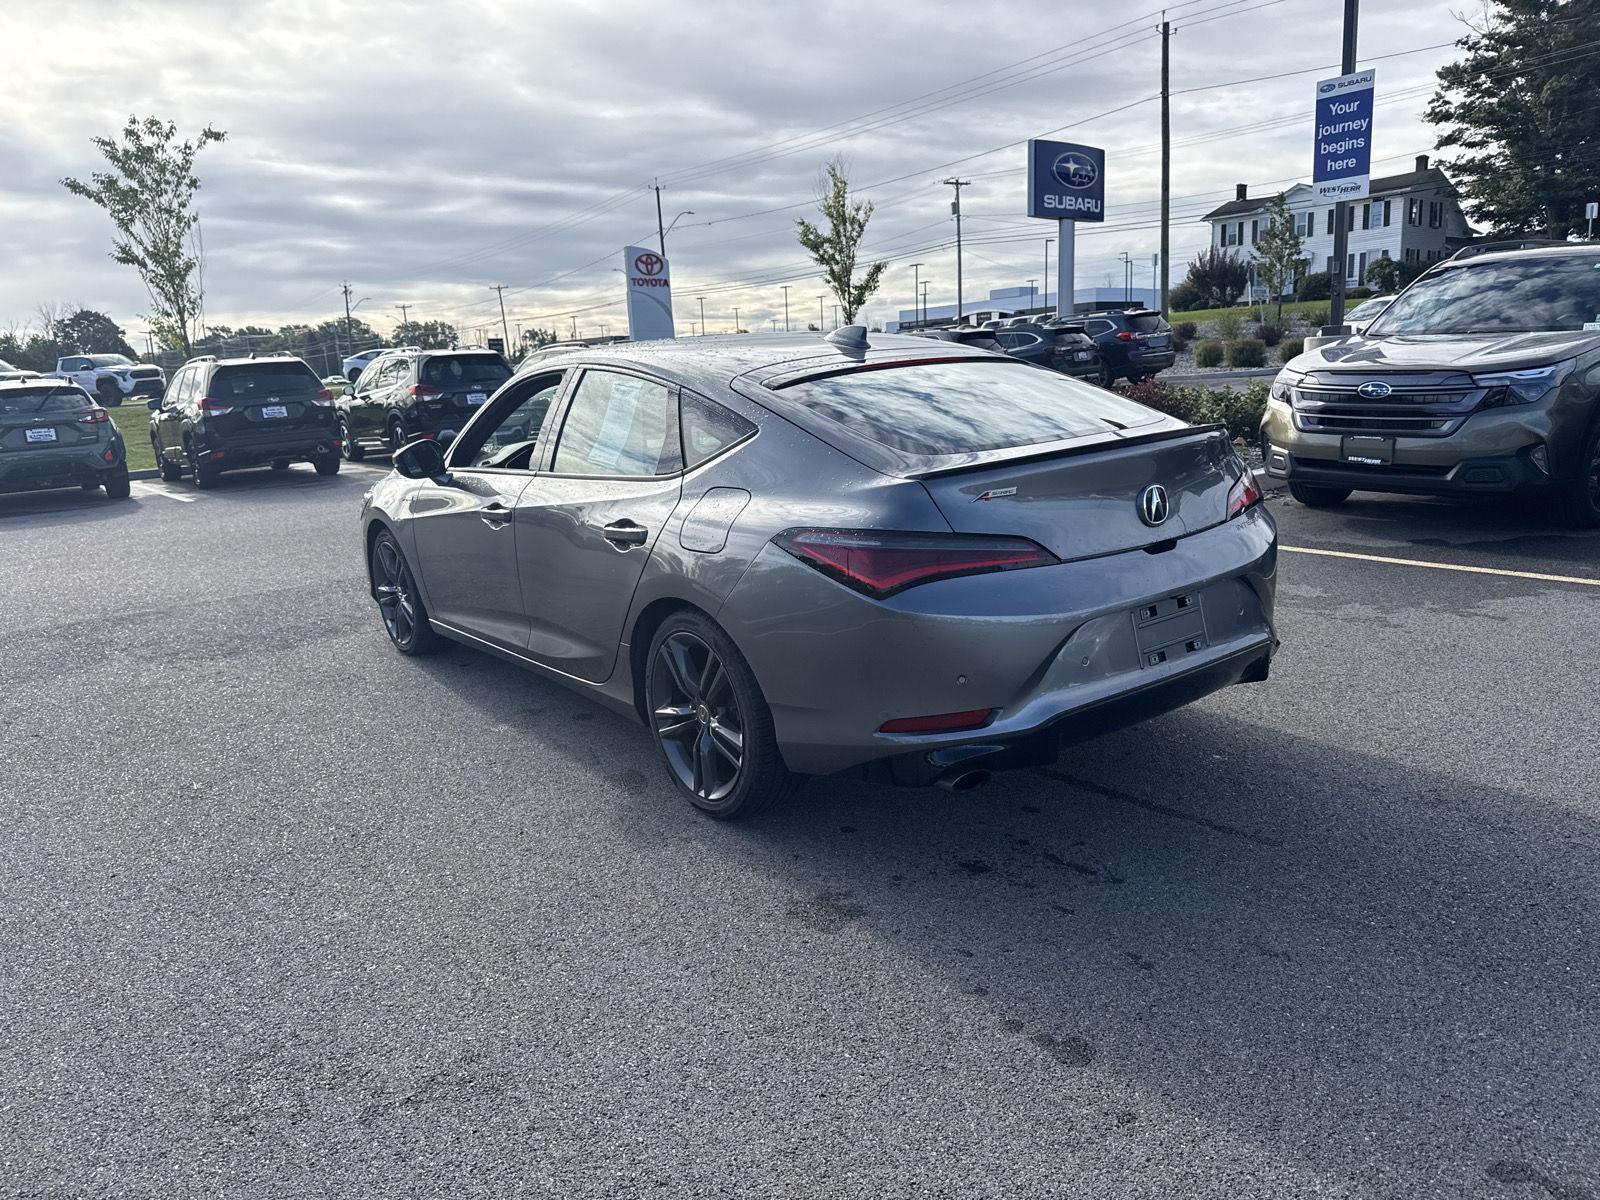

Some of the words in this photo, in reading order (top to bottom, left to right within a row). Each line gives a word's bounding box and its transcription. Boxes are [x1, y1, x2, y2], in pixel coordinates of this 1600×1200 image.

[1338, 75, 1372, 89] SUBARU
[1329, 100, 1360, 116] Your
[1318, 118, 1369, 138] journey
[1320, 137, 1365, 155] begins
[1327, 157, 1357, 172] here
[1043, 194, 1101, 212] SUBARU
[631, 277, 669, 287] TOYOTA
